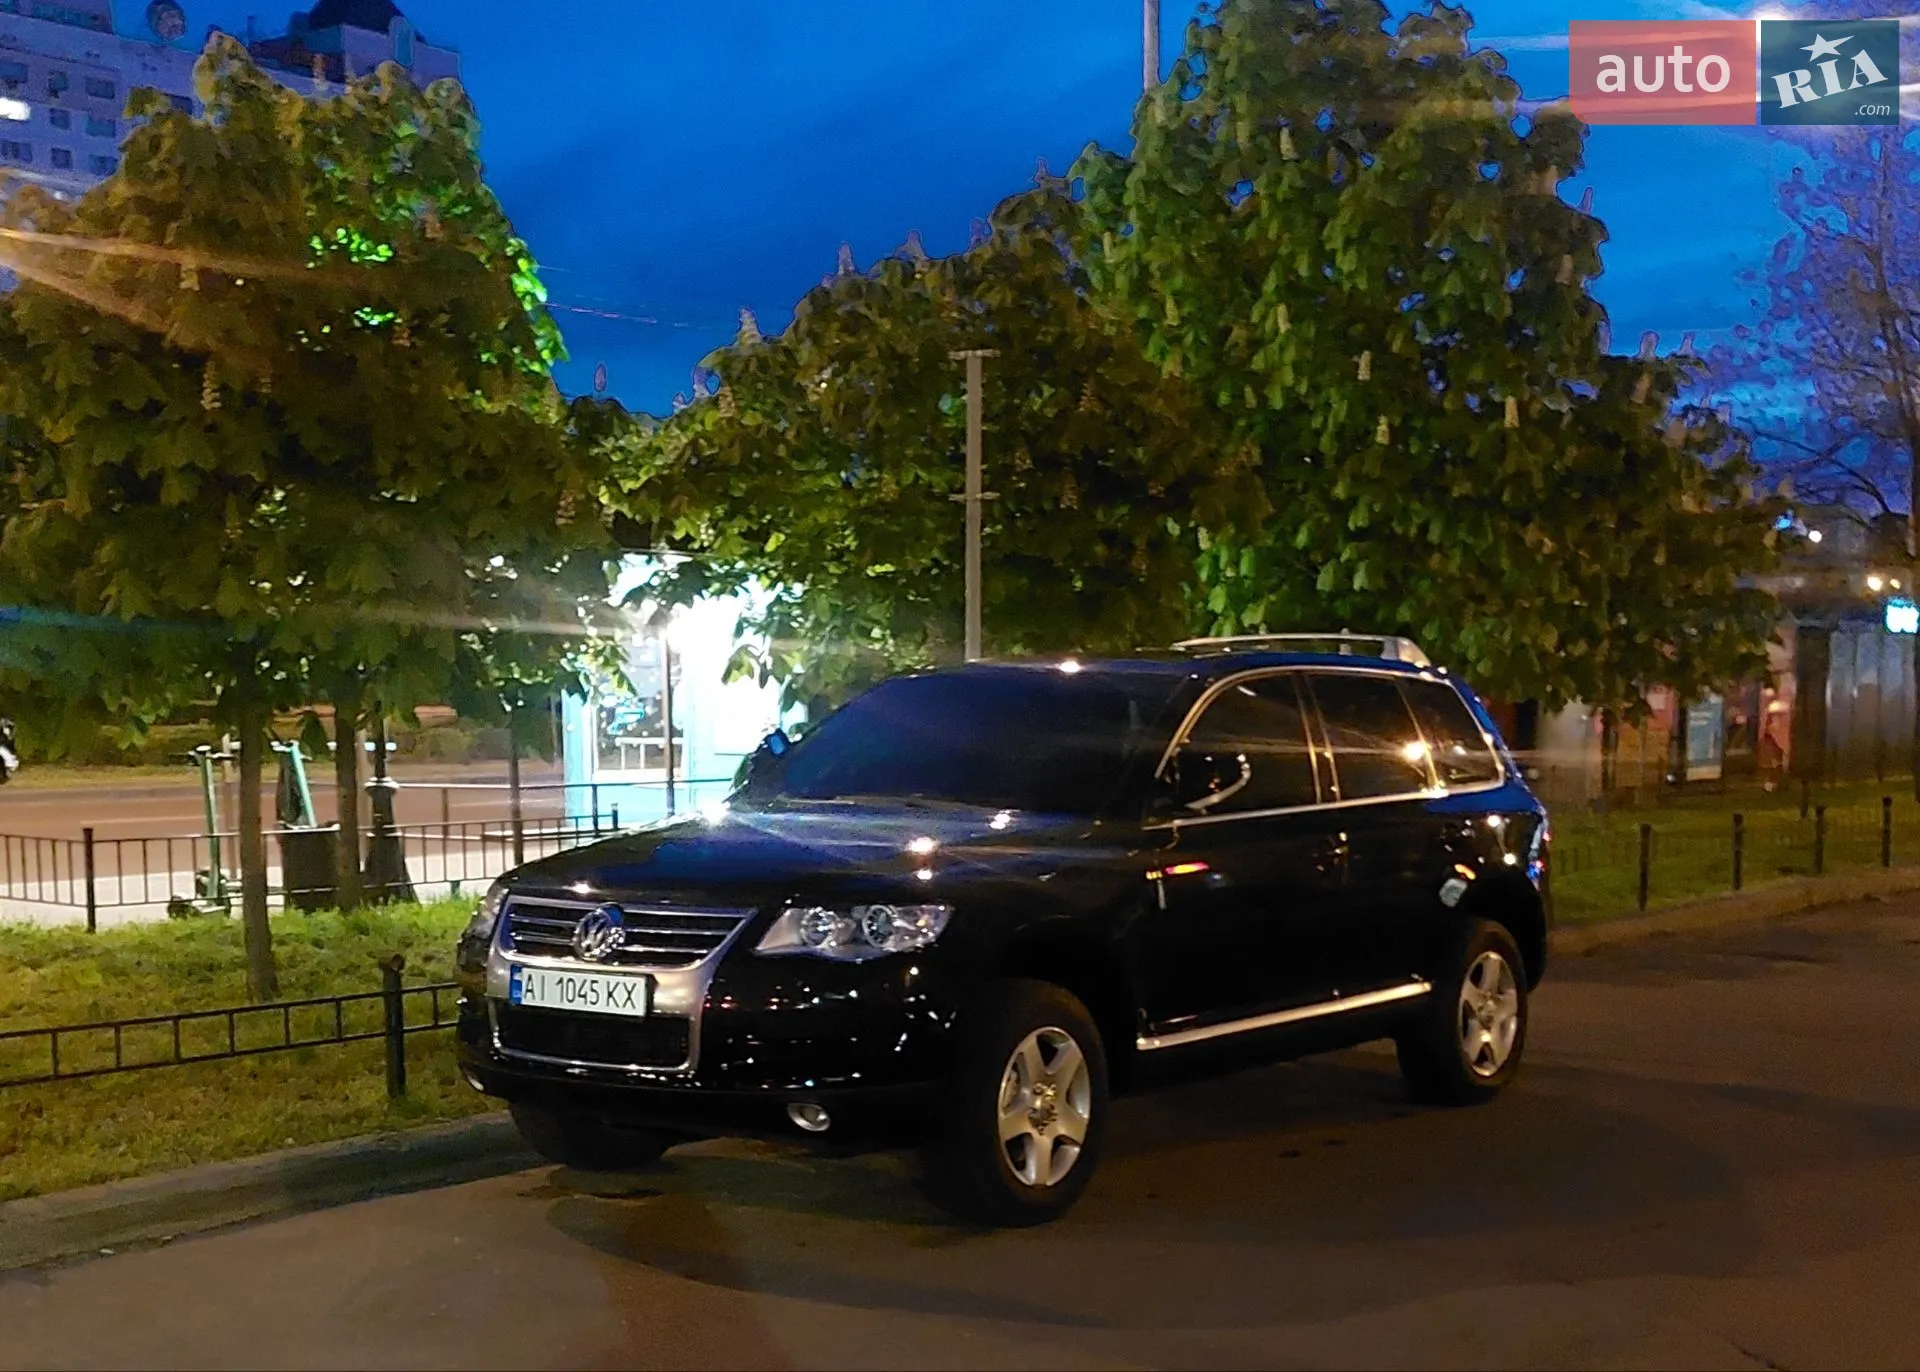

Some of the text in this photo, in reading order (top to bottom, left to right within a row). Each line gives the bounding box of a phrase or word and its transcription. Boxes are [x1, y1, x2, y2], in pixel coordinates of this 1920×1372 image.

[524, 973, 637, 1010] AI 1045 KX
